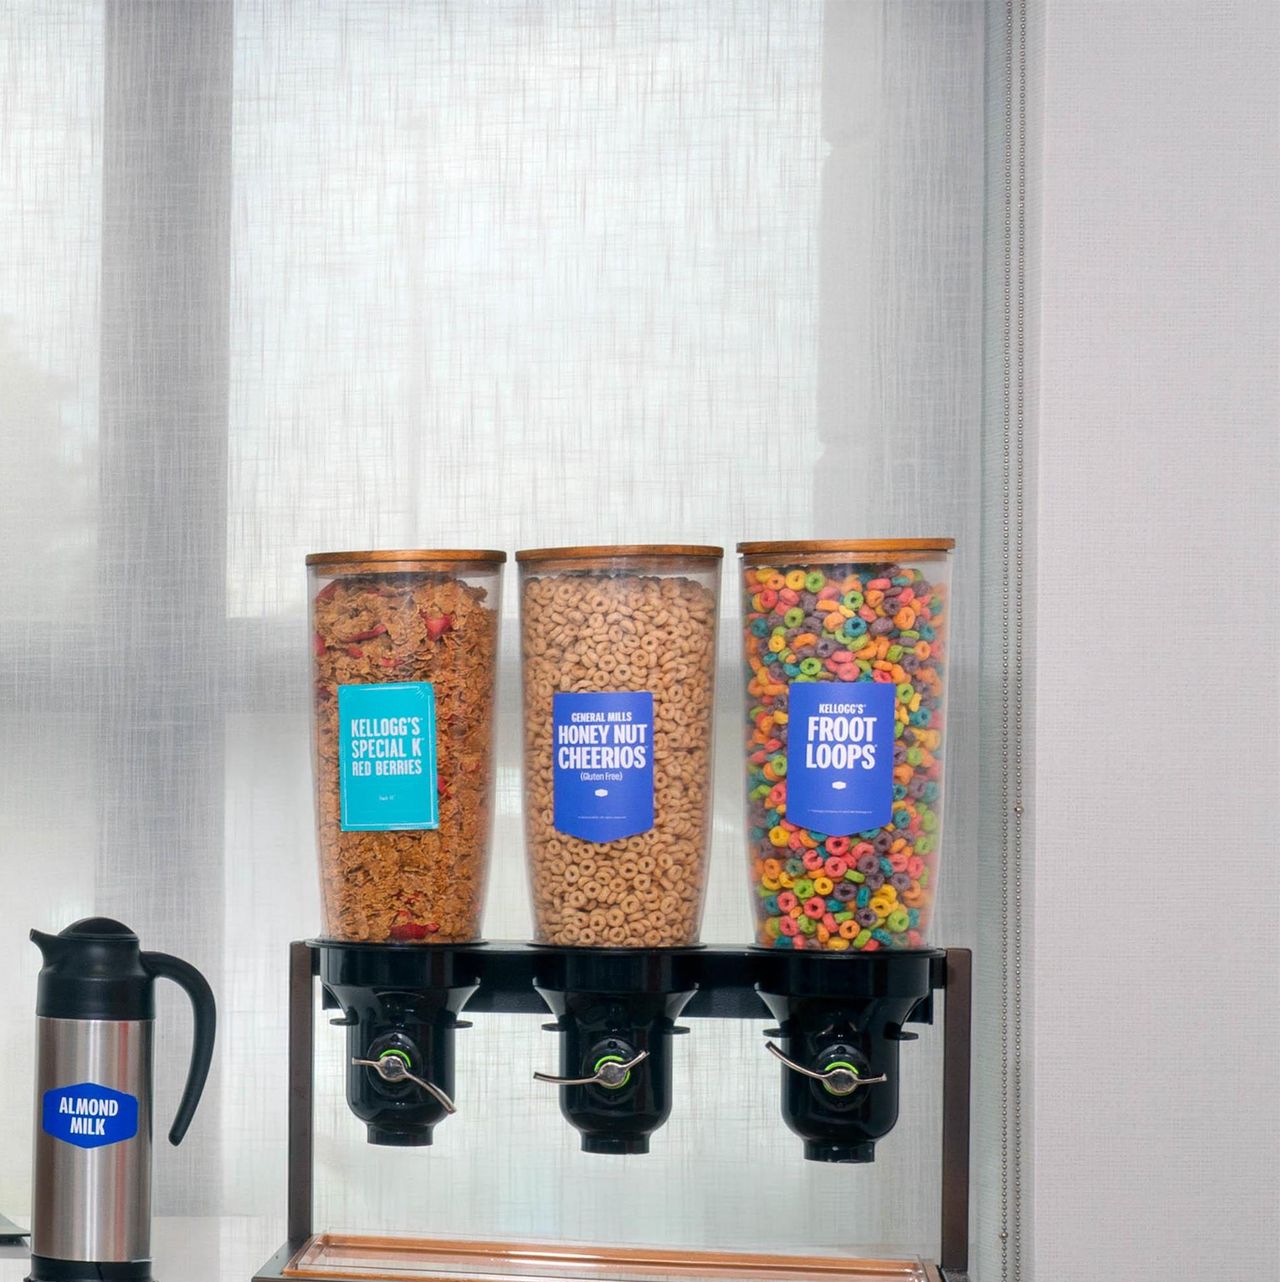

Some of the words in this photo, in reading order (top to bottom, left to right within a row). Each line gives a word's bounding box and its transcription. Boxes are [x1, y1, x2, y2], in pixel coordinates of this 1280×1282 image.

[571, 712, 606, 723] GENERAL
[607, 711, 633, 722] MILLS
[818, 703, 864, 714] KELLOGG'S
[350, 717, 421, 738] KELLOGG'S
[558, 724, 611, 745] HONEY
[613, 724, 648, 744] NUT
[807, 716, 878, 742] FROOT
[351, 738, 407, 759] SPECIAL
[412, 738, 423, 757] K
[557, 746, 647, 769] CHEERIOS
[805, 743, 877, 770] LOOPS
[351, 760, 372, 777] RED
[375, 759, 423, 776] BERRIES
[580, 771, 604, 781] (Gluten
[605, 771, 623, 781] Free)
[58, 1096, 119, 1117] ALMOND
[69, 1117, 106, 1136] MILK
